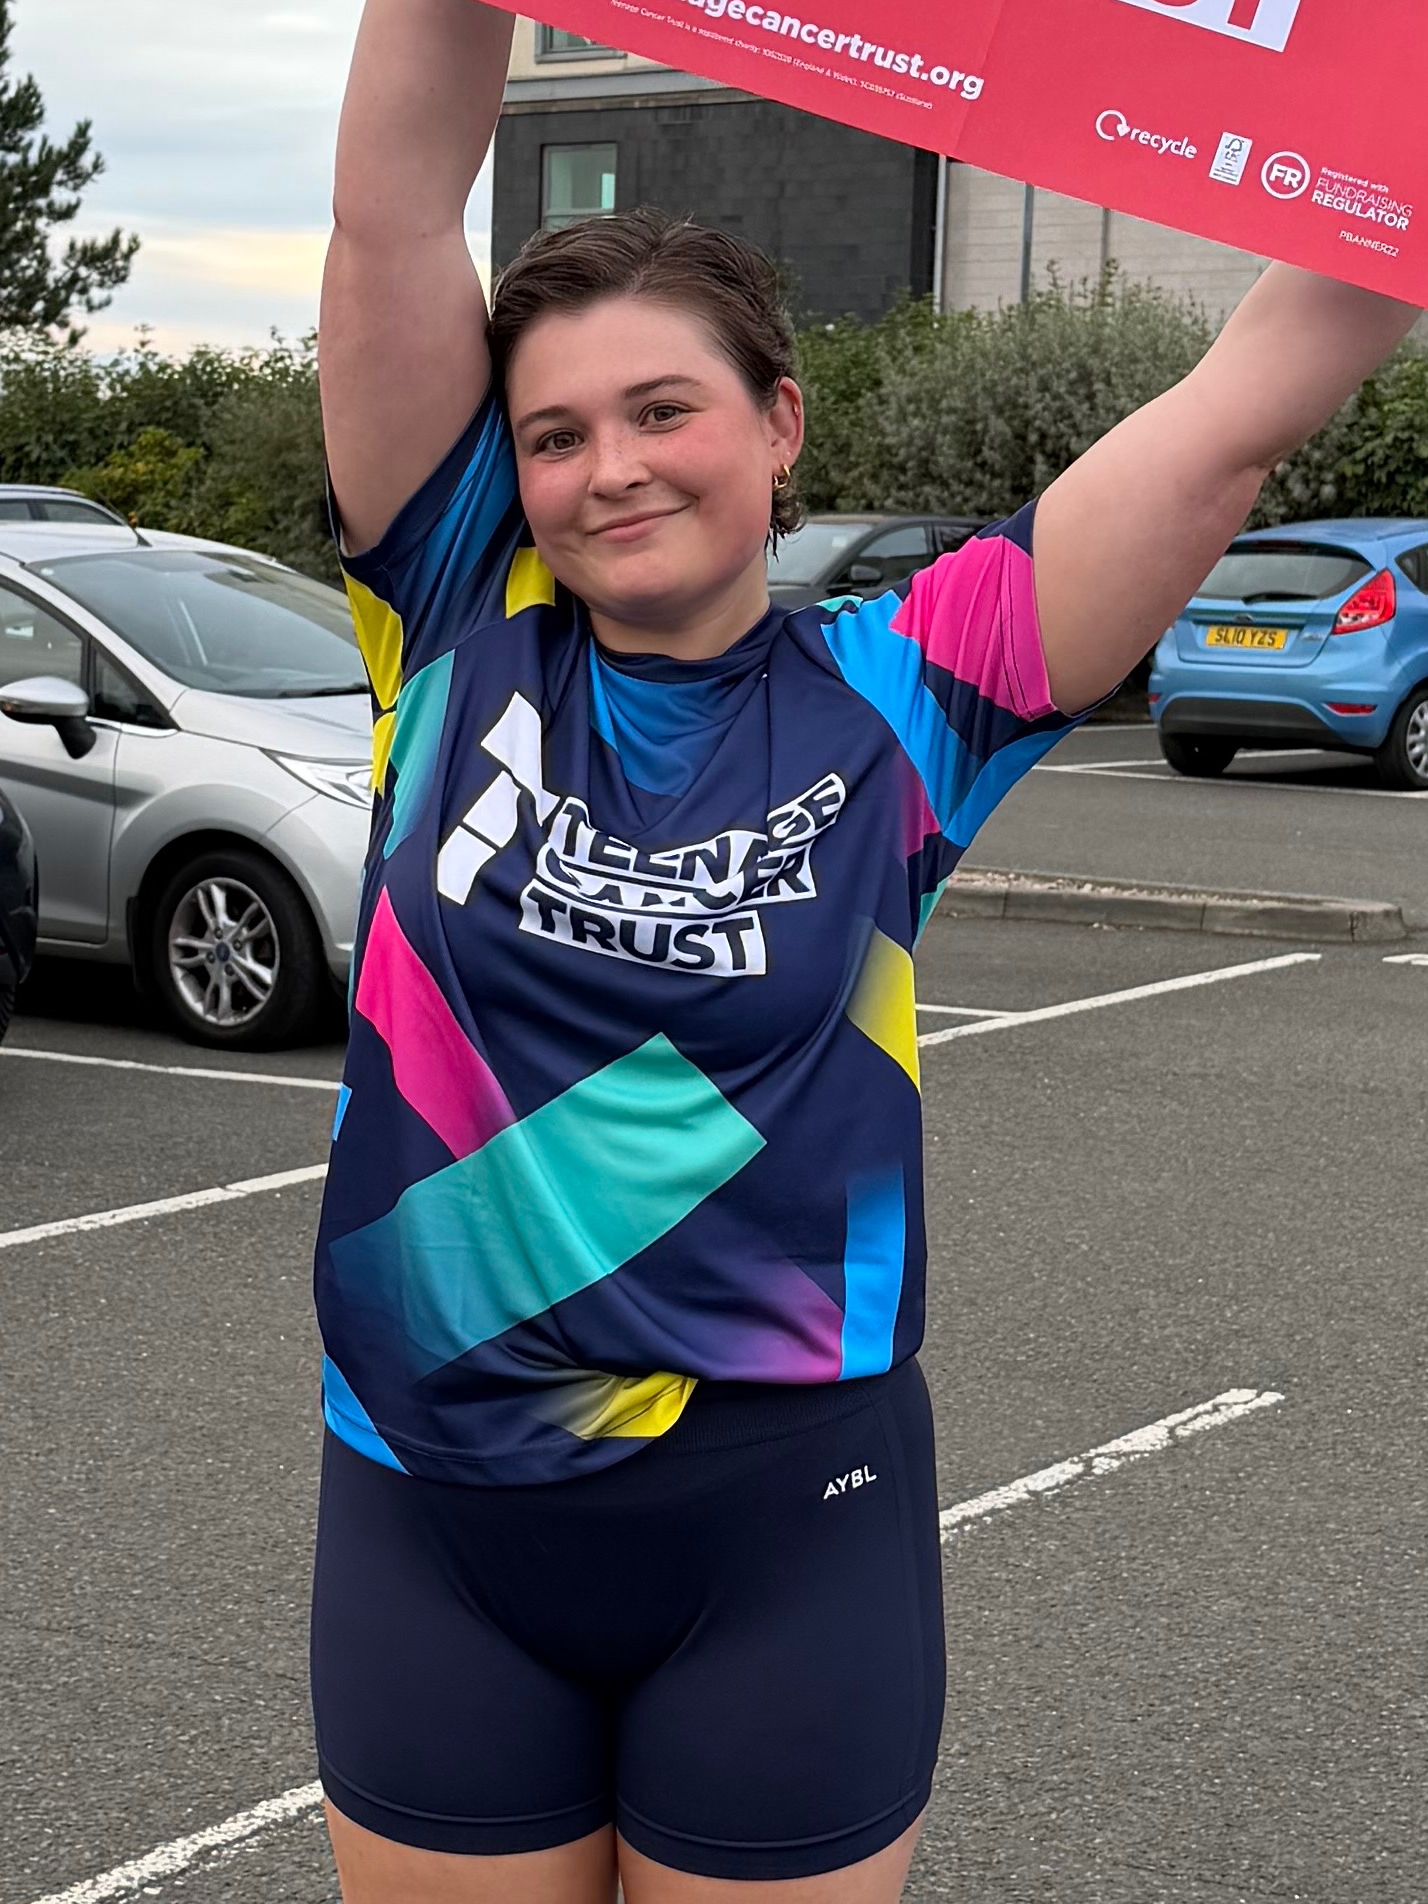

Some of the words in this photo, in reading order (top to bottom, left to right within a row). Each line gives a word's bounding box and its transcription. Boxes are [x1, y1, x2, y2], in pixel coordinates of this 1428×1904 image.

[1129, 127, 1198, 159] recycle
[1269, 163, 1303, 189] FR
[1321, 166, 1369, 188] Registered
[1311, 189, 1410, 231] REGULATOR
[1315, 177, 1413, 218] FUNDRAISING
[1250, 628, 1278, 647] YZS
[524, 885, 754, 971] TRUST
[823, 1465, 878, 1500] AYBL
